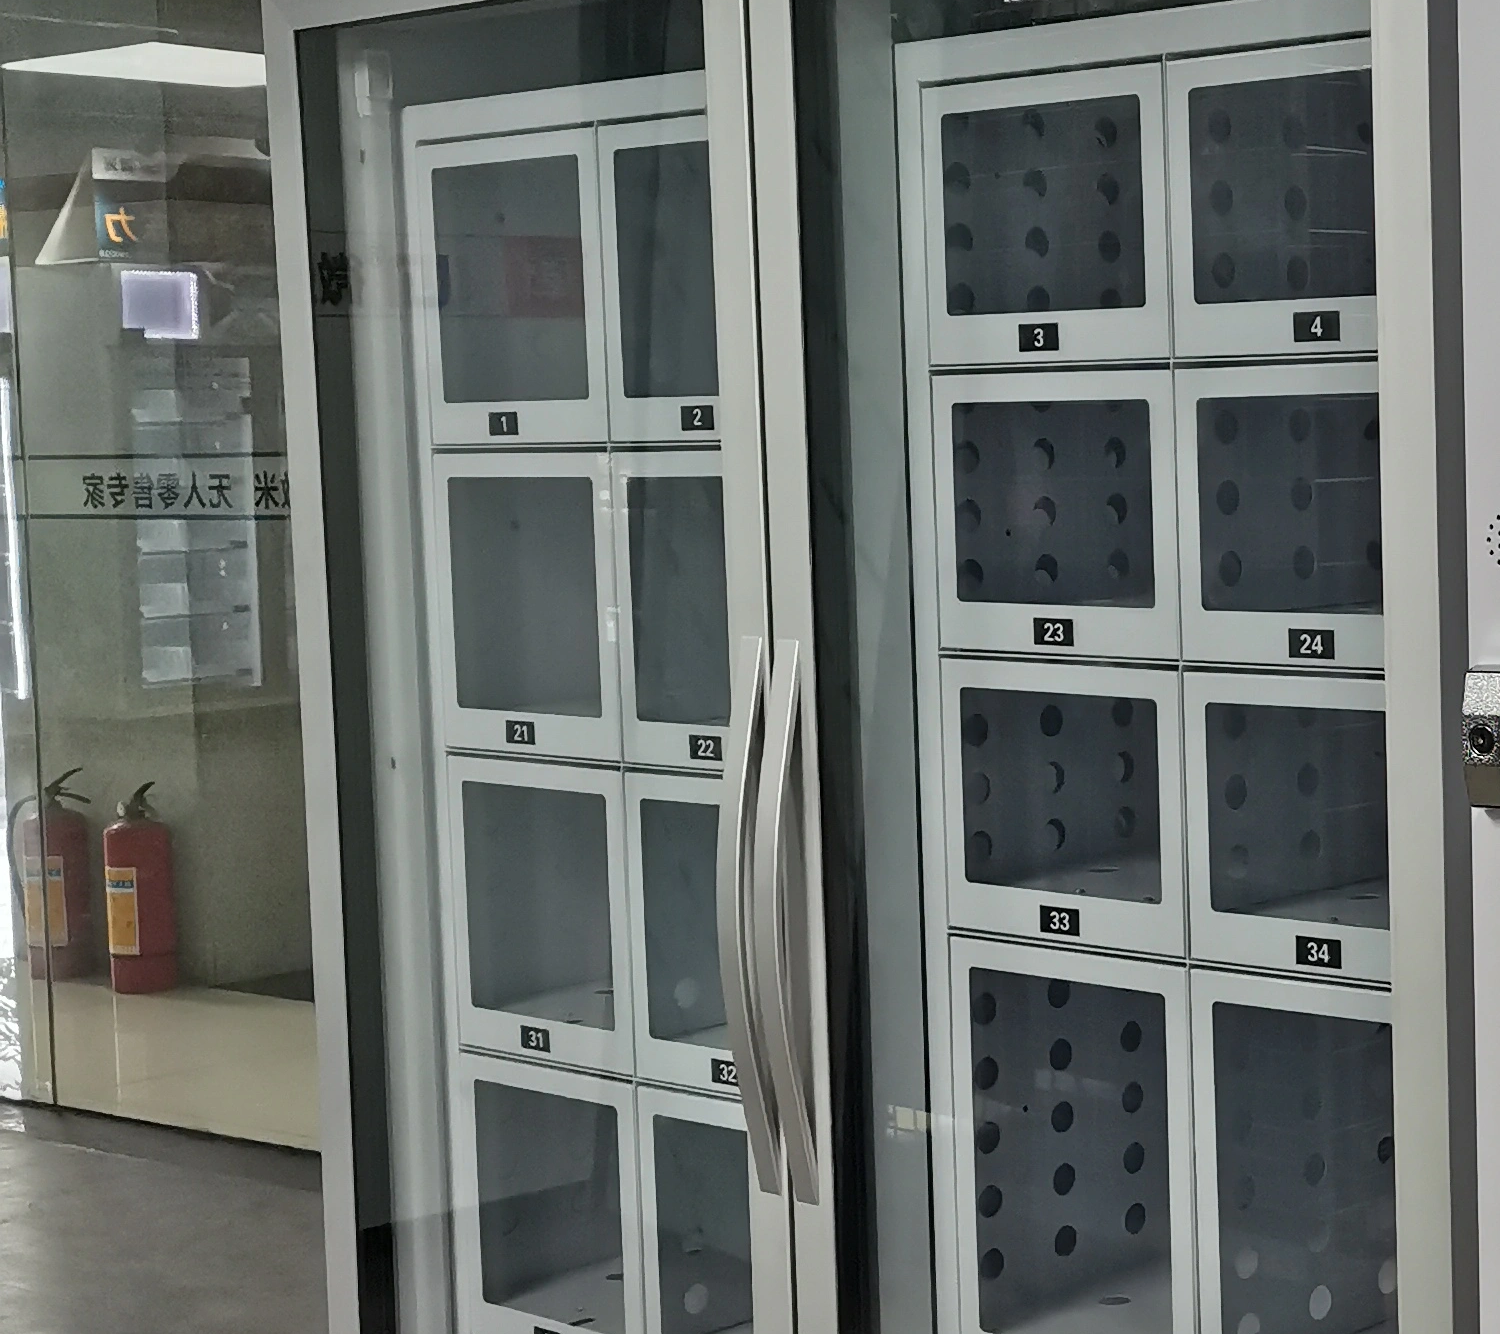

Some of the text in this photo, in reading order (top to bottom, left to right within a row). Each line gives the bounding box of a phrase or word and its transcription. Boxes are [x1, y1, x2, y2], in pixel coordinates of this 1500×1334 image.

[1310, 315, 1323, 337] 4
[1033, 328, 1044, 348] 3
[500, 415, 508, 433] 1
[692, 408, 703, 426] 2
[1043, 622, 1064, 642] 23
[1299, 633, 1324, 655] 24
[513, 724, 529, 742] 21
[697, 738, 715, 757] 22
[1049, 911, 1070, 931] 33
[1307, 941, 1329, 963] 34
[528, 1030, 544, 1048] 31
[719, 1064, 737, 1083] 32
